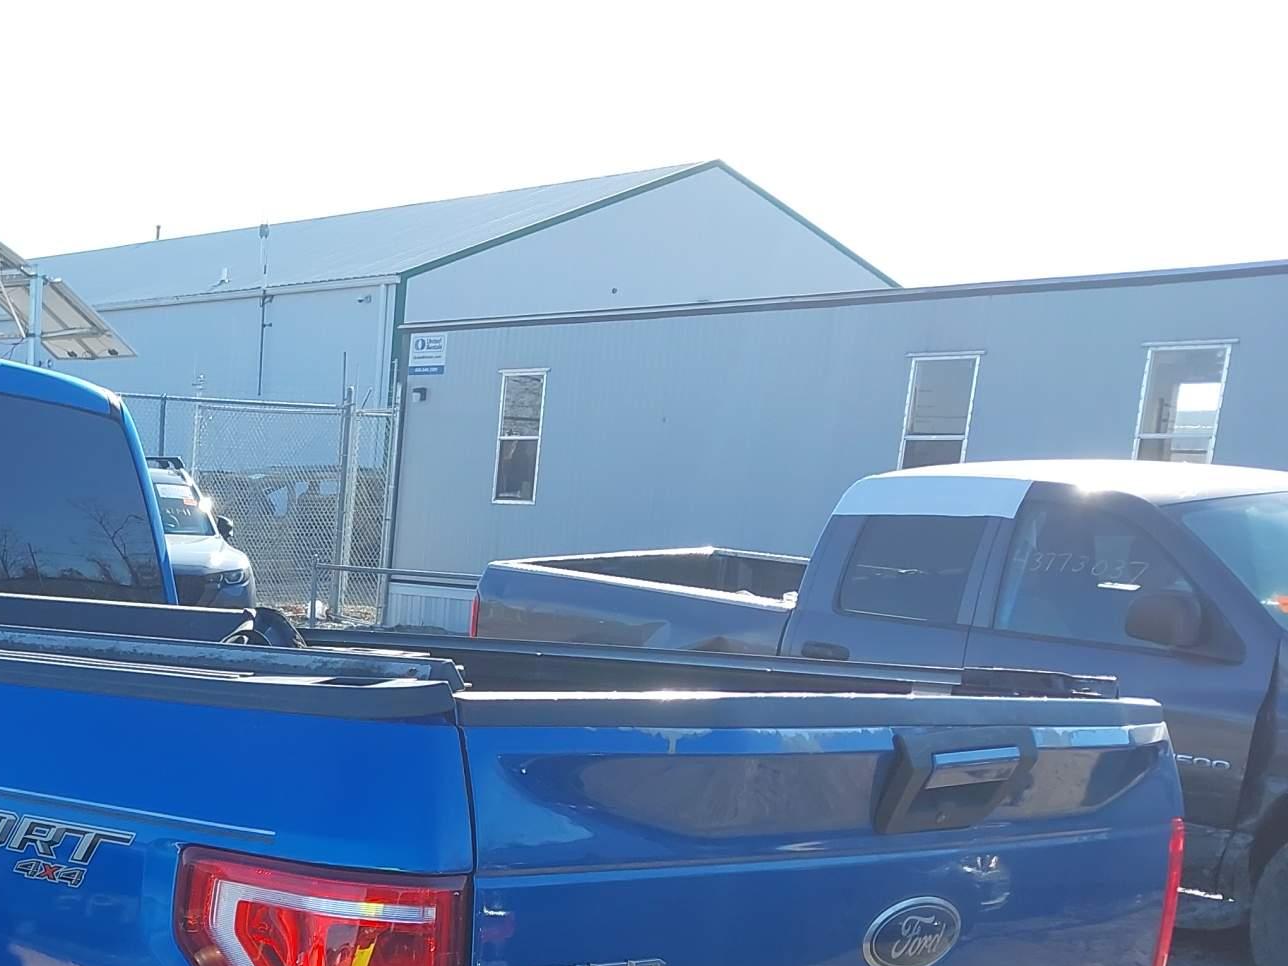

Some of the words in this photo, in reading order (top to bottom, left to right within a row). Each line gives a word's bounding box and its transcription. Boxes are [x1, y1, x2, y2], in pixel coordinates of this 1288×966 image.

[1012, 548, 1150, 583] 43773037
[1173, 753, 1231, 769] 500
[891, 915, 946, 959] Ford
